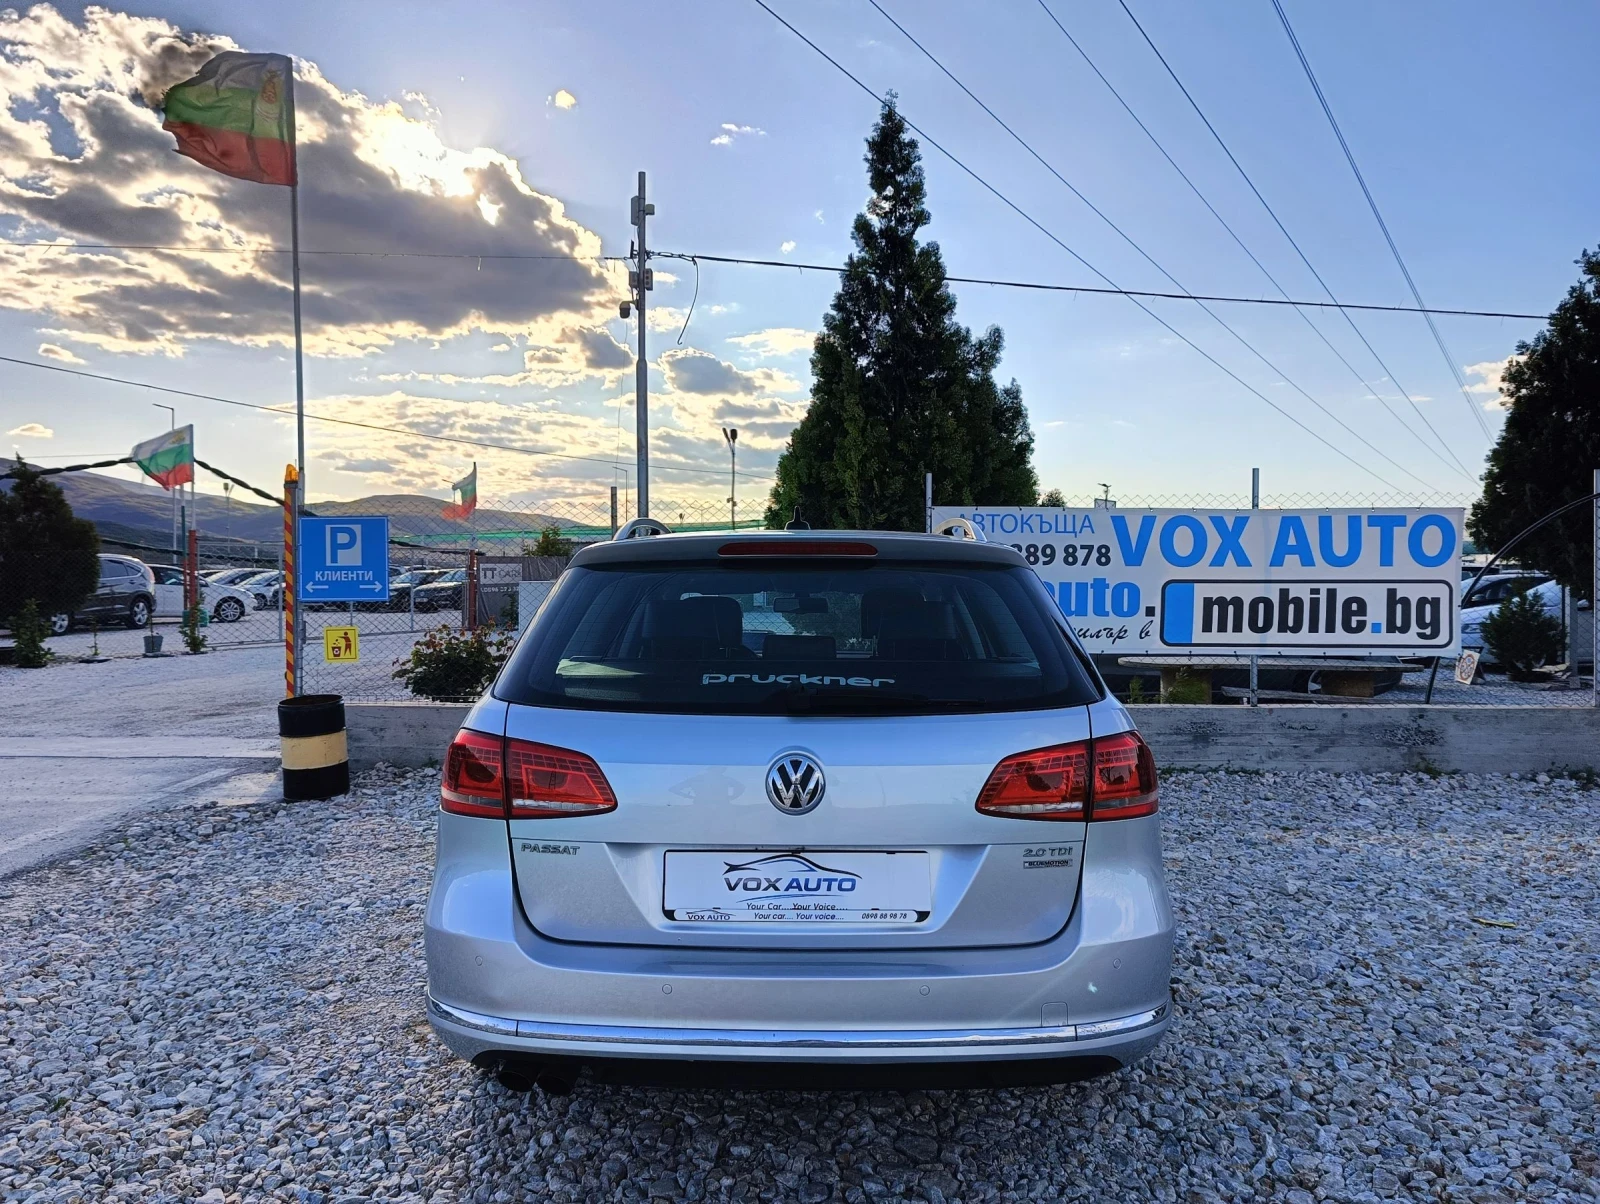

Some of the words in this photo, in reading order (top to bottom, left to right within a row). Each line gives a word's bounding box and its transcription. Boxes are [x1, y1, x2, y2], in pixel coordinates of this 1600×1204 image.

[330, 526, 358, 564] P
[1109, 514, 1253, 568] VOX
[1268, 514, 1457, 568] AUTO
[1062, 544, 1112, 567] 878
[315, 570, 374, 581] КЛИЕНТИ
[1201, 587, 1442, 641] mobile.bg
[1073, 624, 1129, 645] илър
[702, 673, 896, 687] pruckner
[521, 843, 580, 855] PASSAT
[1048, 846, 1073, 857] TDI
[746, 902, 766, 911] Your
[754, 912, 772, 920] Your
[796, 912, 813, 920] Your
[861, 912, 878, 920] 0898
[889, 912, 898, 920] 98
[899, 912, 908, 920] 78
